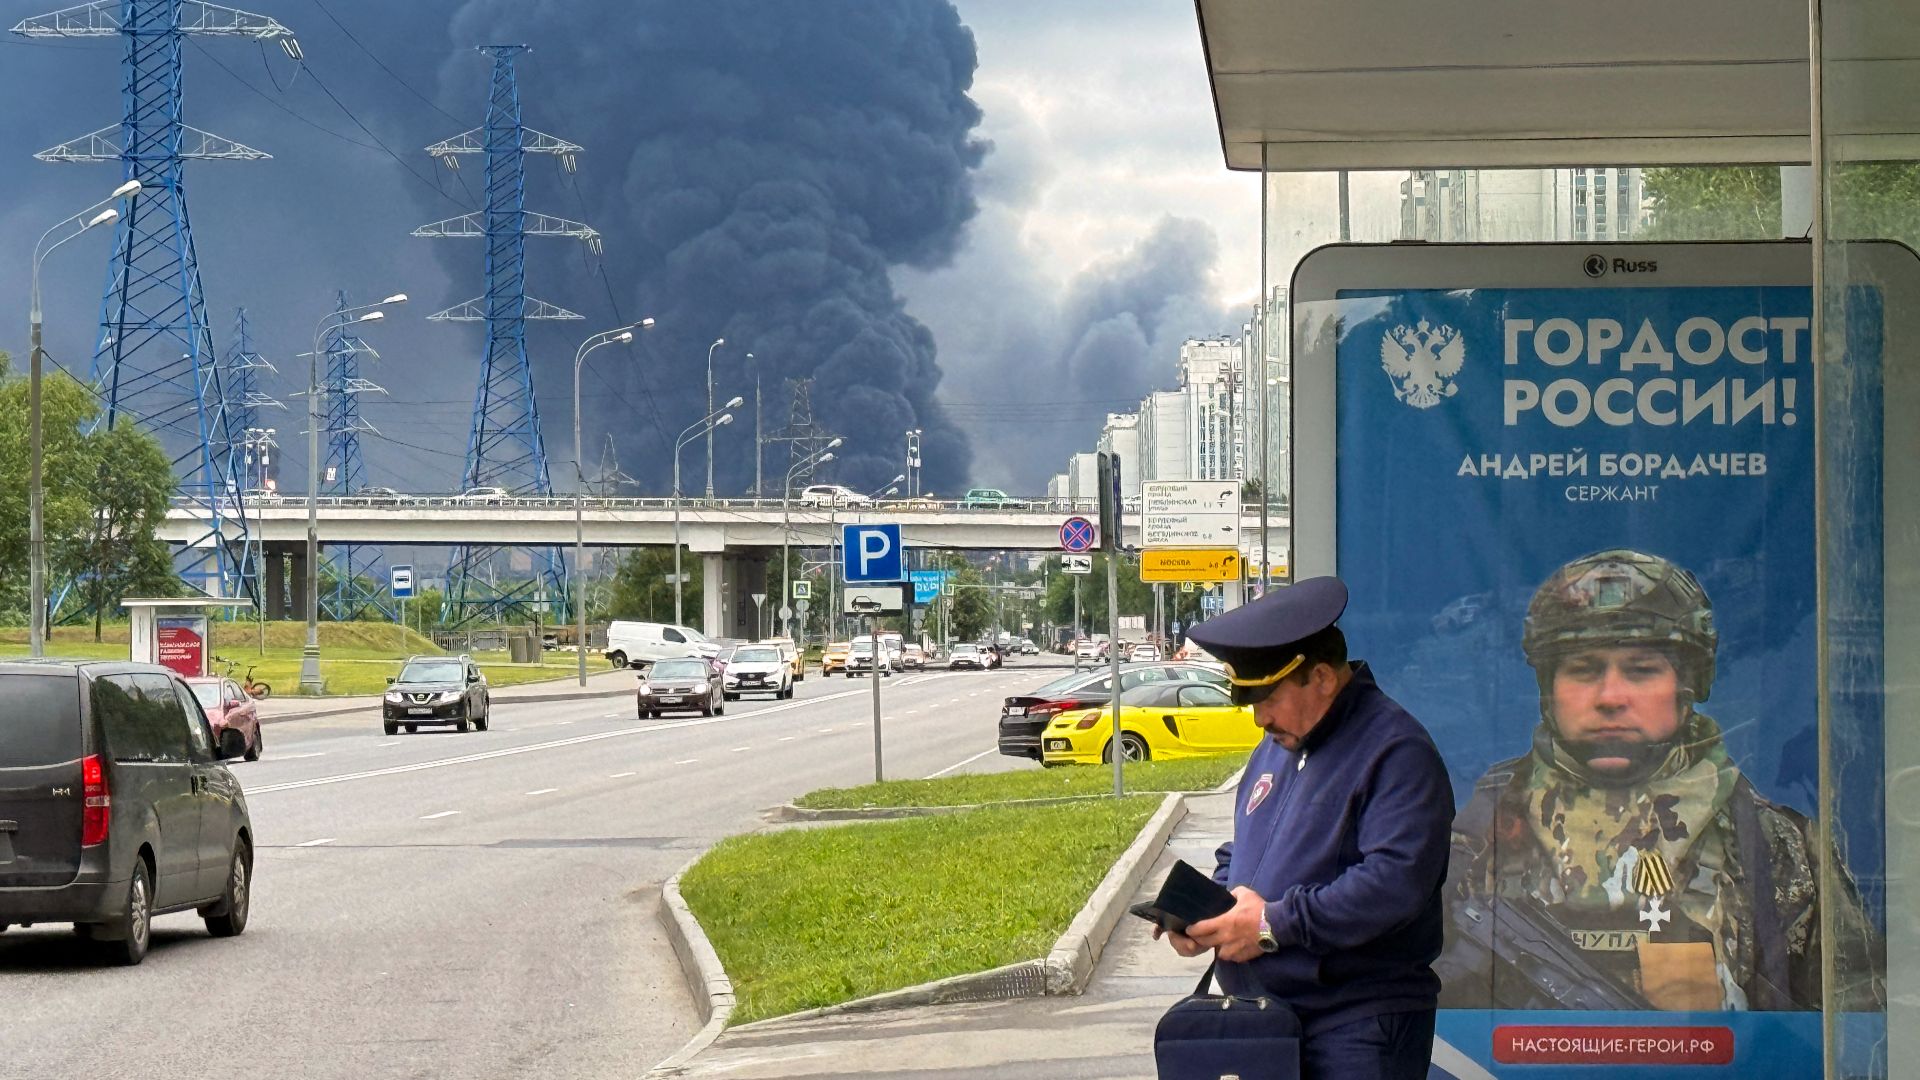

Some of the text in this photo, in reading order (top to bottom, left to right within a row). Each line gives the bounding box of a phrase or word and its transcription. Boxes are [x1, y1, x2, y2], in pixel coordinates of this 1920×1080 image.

[1613, 258, 1657, 273] Russ
[1504, 316, 1815, 371] ГОРДОСТ
[1504, 377, 1797, 427] РОССИИ!
[1457, 448, 1767, 480] АНДРЕЙ БОРДАЧЕВ
[1565, 485, 1659, 502] СЕРЖАНТ
[859, 530, 891, 576] P
